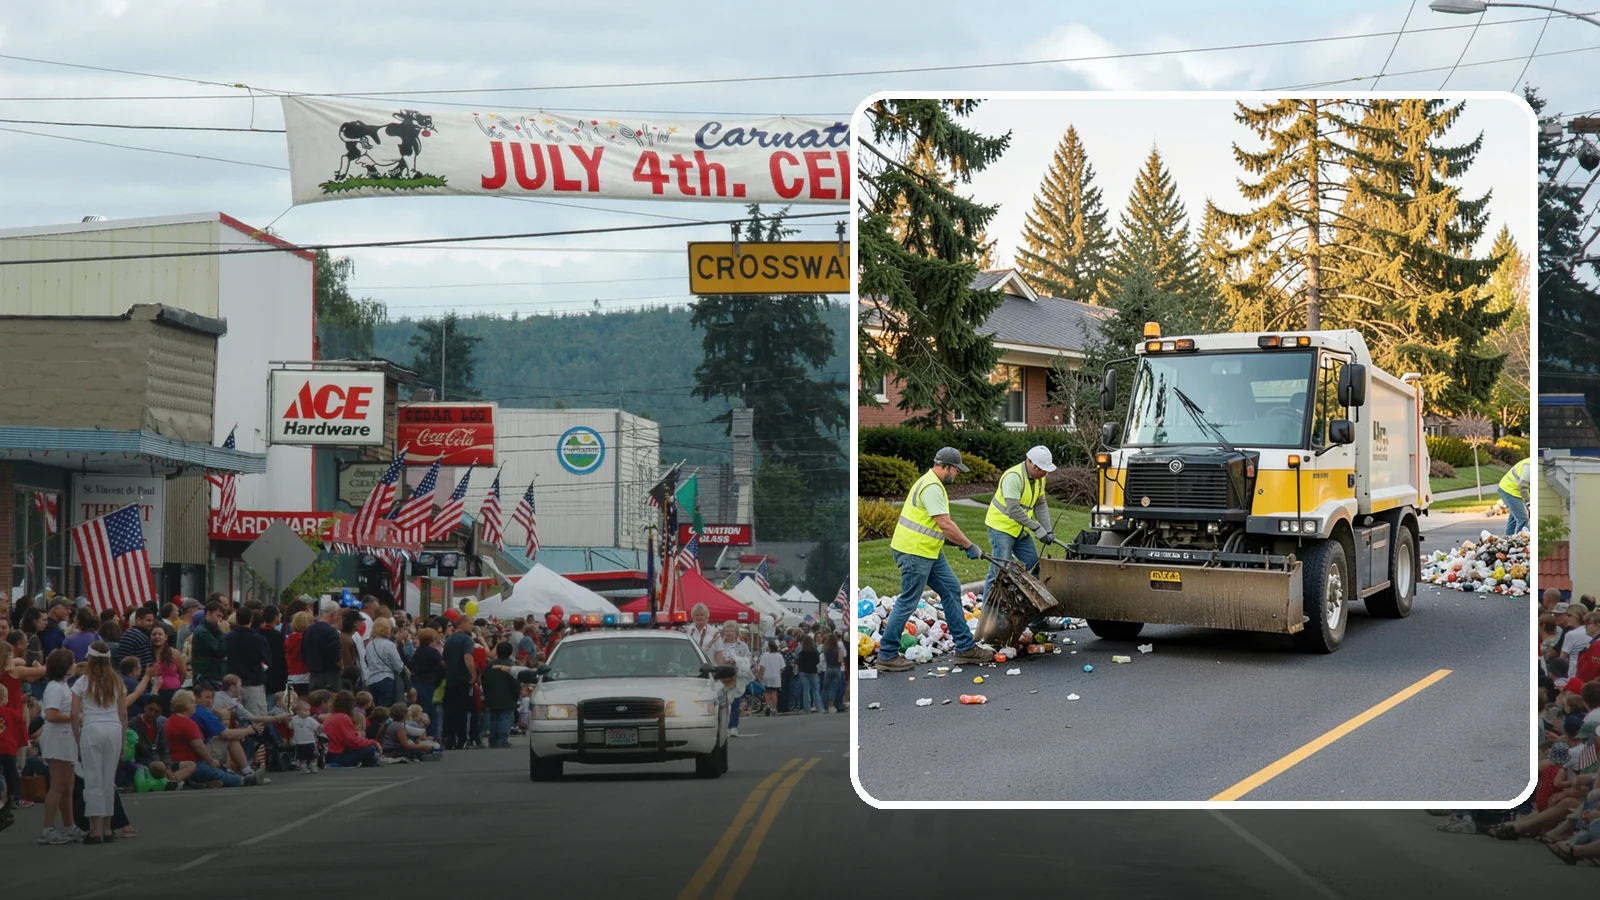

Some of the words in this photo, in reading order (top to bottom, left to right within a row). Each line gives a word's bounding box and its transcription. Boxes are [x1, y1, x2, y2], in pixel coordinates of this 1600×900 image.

[481, 141, 605, 193] JULY
[632, 150, 746, 198] 4th.
[696, 254, 850, 280] CROSSWA
[283, 380, 373, 420] ACE
[405, 409, 453, 422] CEDAR
[283, 421, 371, 437] Hardware
[416, 428, 477, 447] Coca-Cola
[353, 467, 386, 480] Simpl
[95, 485, 124, 495] Vincent
[126, 486, 136, 495] de
[138, 486, 155, 496] Paul
[81, 503, 154, 522] THT
[212, 516, 330, 536] HARDARE
[688, 526, 741, 535] CRNATION
[699, 535, 730, 543] GLASS
